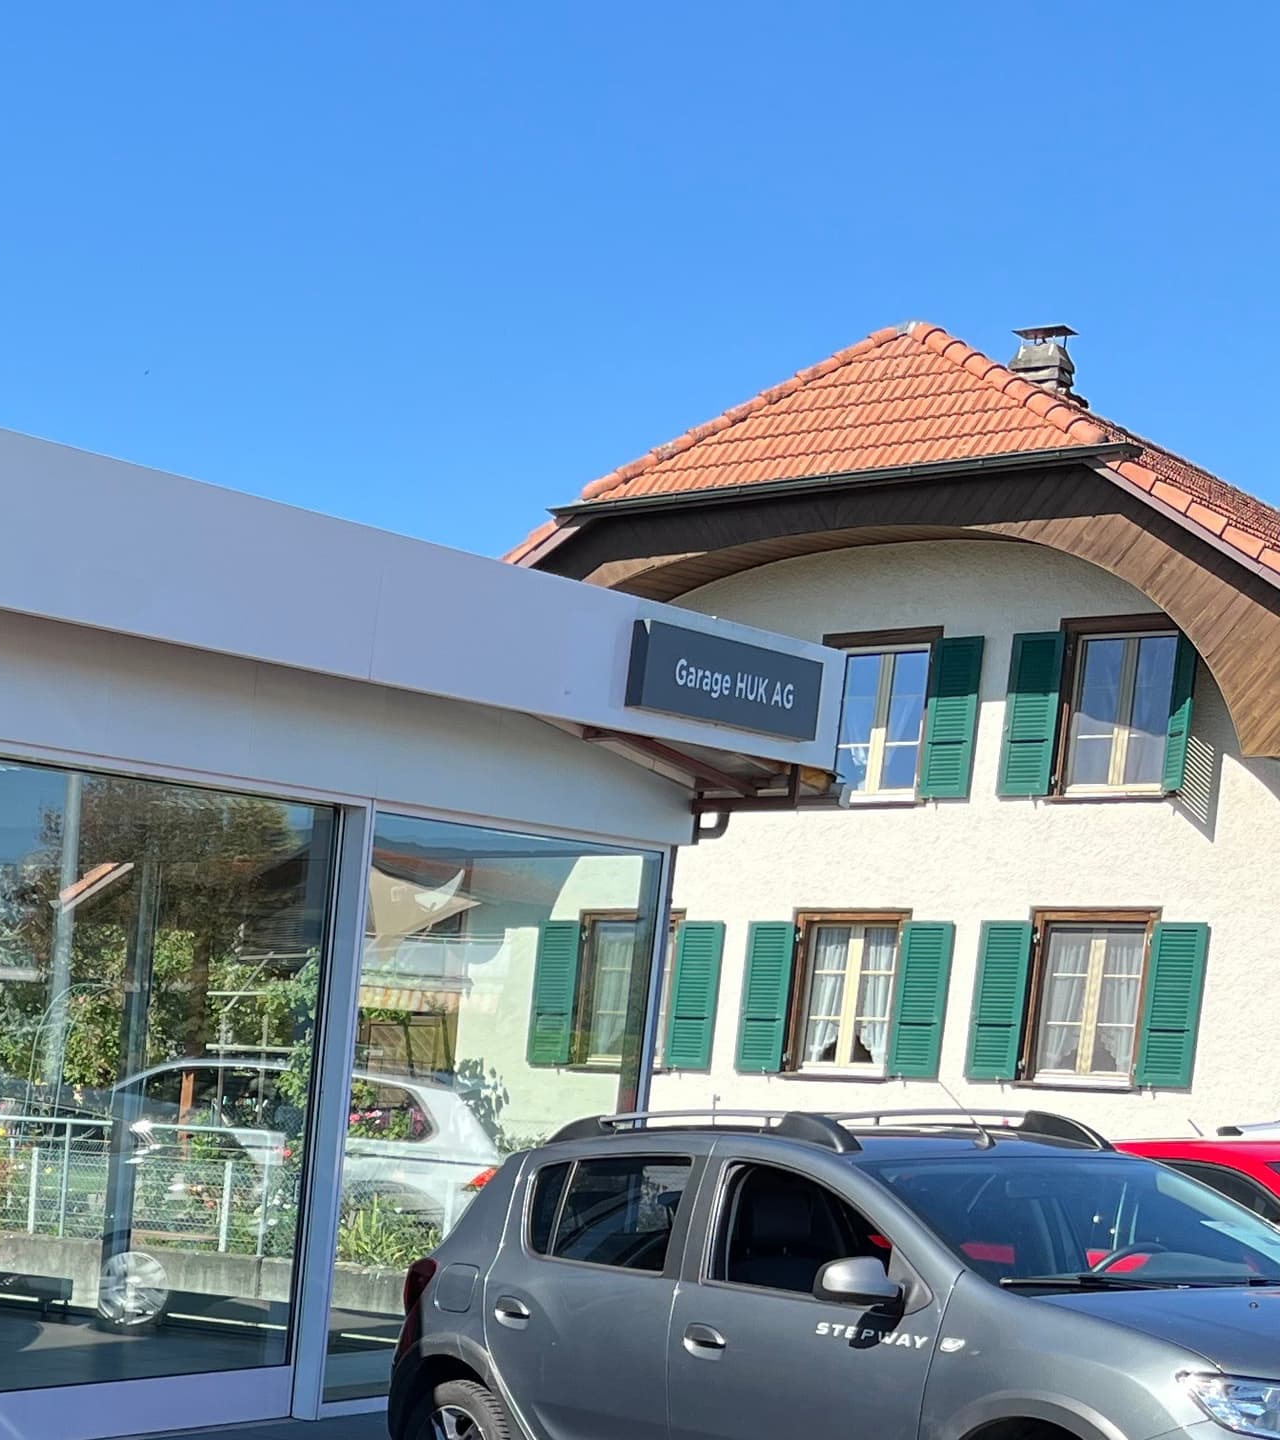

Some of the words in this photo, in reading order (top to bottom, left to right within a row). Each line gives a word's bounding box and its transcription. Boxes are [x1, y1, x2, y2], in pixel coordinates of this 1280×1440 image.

[674, 658, 731, 698] Garage
[735, 671, 767, 705] HUK
[771, 681, 795, 709] AG
[815, 1322, 929, 1349] STEPWAY
